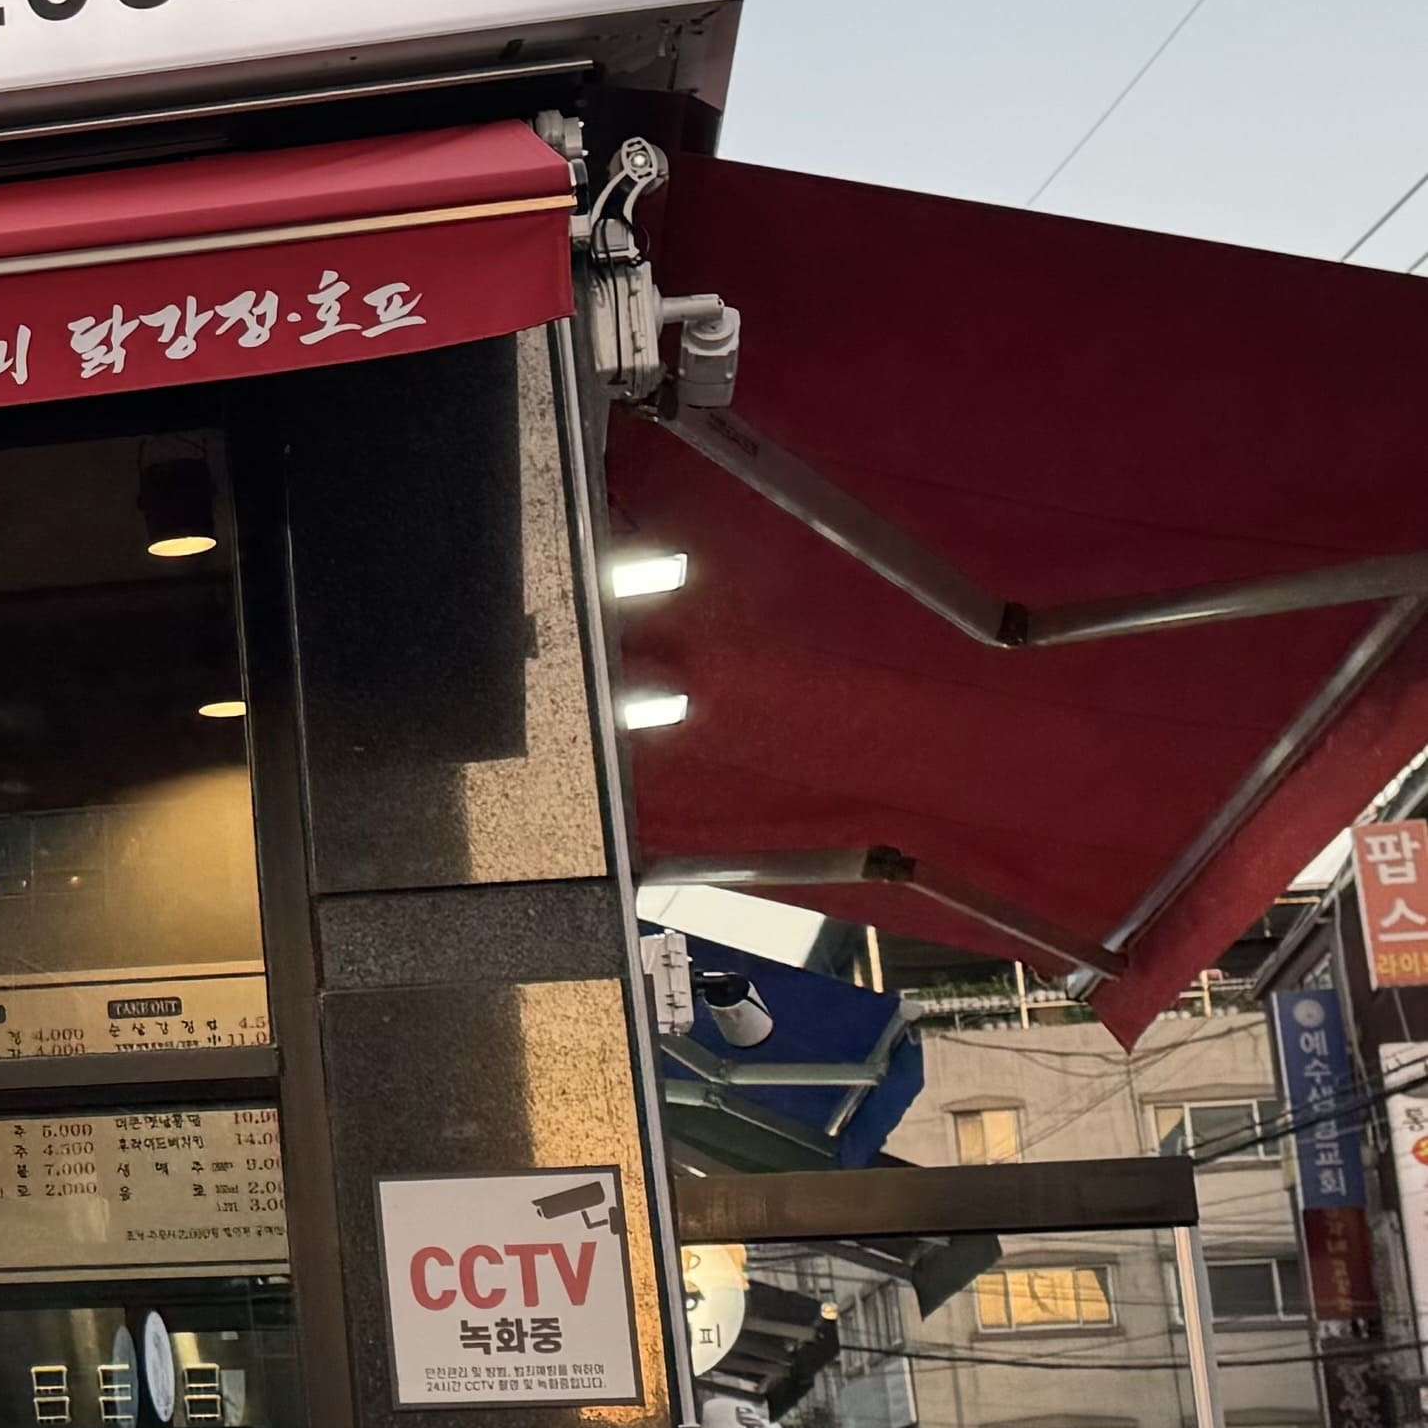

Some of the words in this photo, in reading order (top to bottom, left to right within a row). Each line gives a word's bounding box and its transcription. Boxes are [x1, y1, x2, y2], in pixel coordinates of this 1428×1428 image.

[410, 1241, 597, 1311] CCTV
[459, 1317, 563, 1356] 녹화중
[464, 1379, 495, 1391] CCTV
